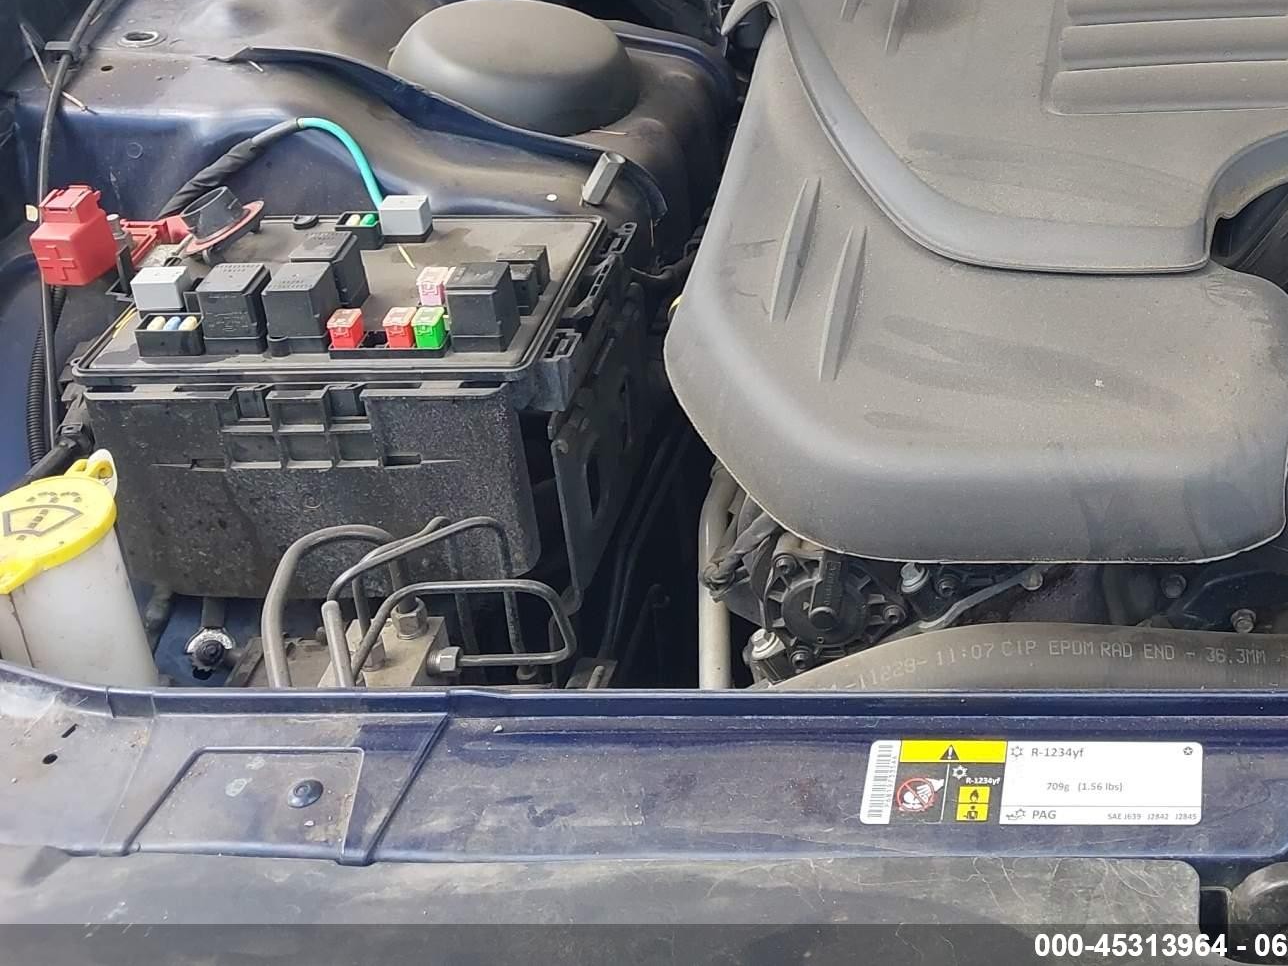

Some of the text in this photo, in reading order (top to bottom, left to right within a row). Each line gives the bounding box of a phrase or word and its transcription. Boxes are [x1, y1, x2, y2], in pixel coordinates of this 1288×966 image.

[1049, 640, 1094, 656] EPDM
[1101, 641, 1134, 658] RAD
[1143, 643, 1176, 661] END
[1205, 646, 1267, 664] 36.3MM
[1031, 747, 1084, 759] R-1234yf
[965, 776, 1001, 786] R-1234yf
[1046, 782, 1123, 792] 709g (1.56 lbs)
[1032, 810, 1057, 820] PAG
